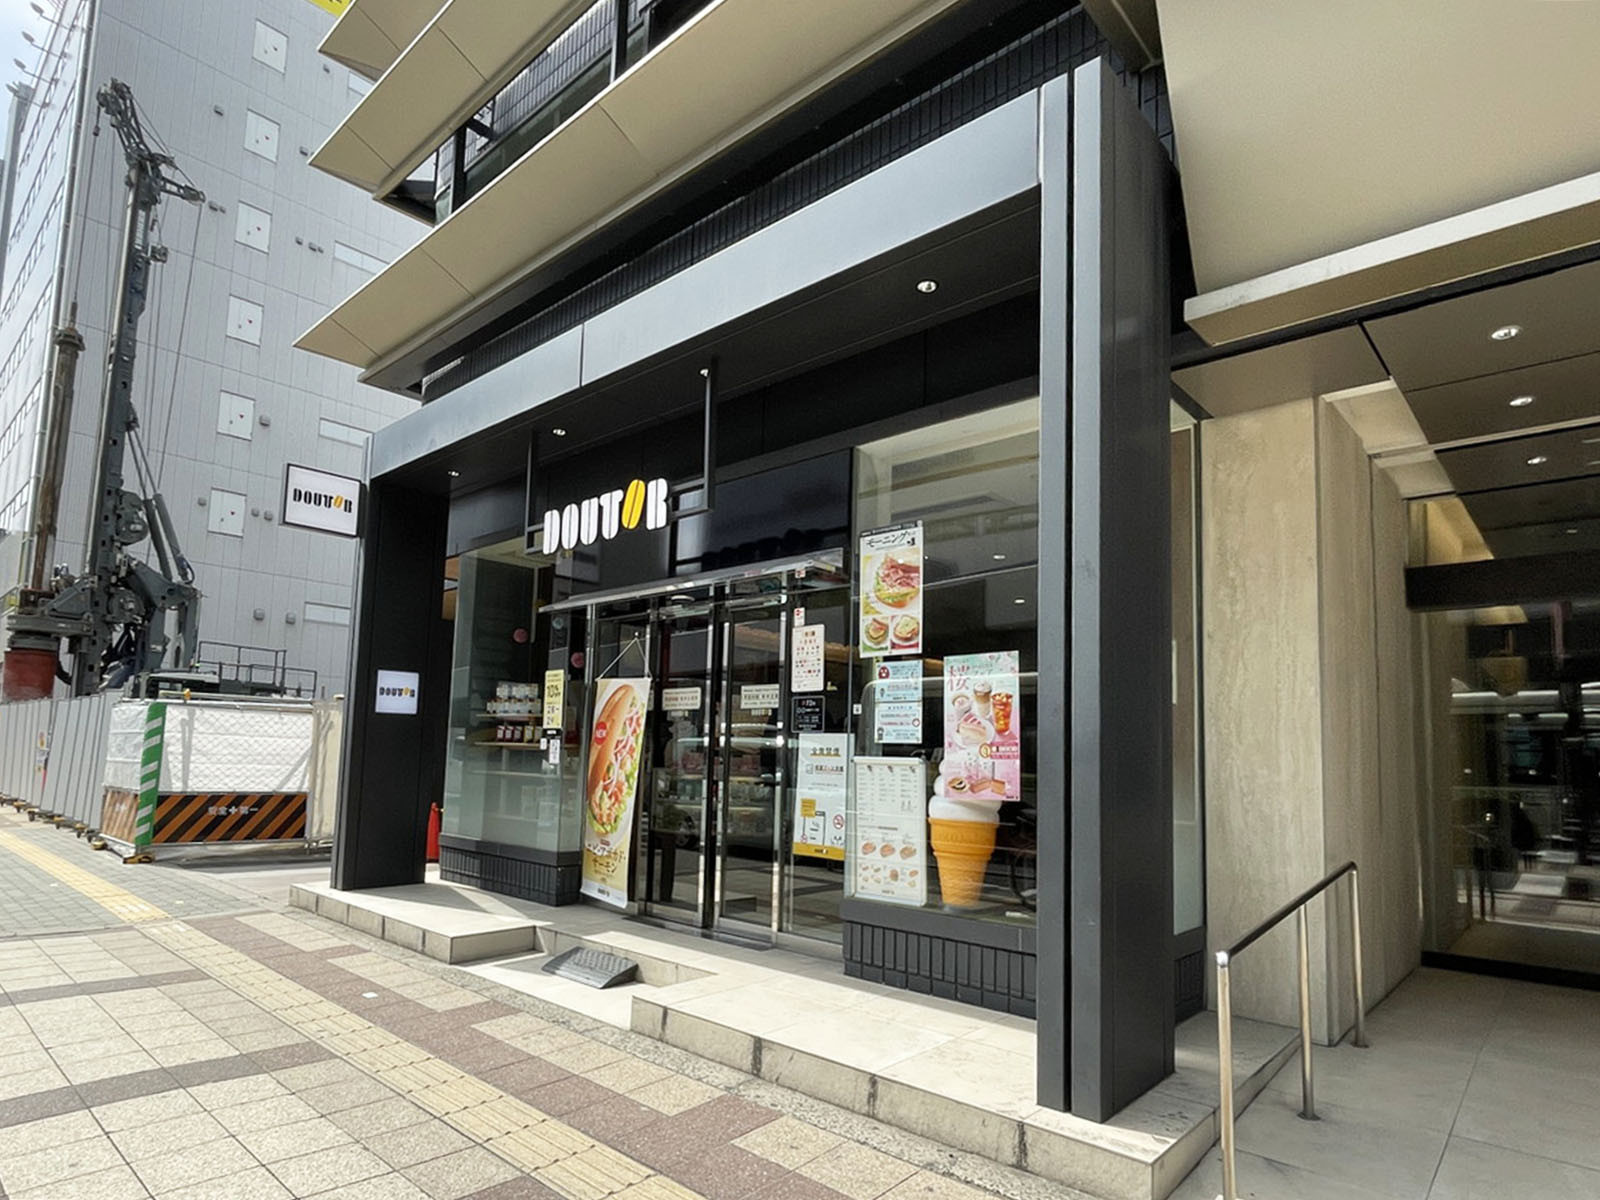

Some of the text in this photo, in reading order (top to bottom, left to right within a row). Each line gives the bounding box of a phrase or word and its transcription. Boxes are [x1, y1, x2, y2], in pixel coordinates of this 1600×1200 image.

[293, 488, 353, 513] DOUTOR
[543, 478, 668, 555] DOUTOR
[866, 531, 908, 548] モーニング
[379, 686, 416, 698] DOUTOR
